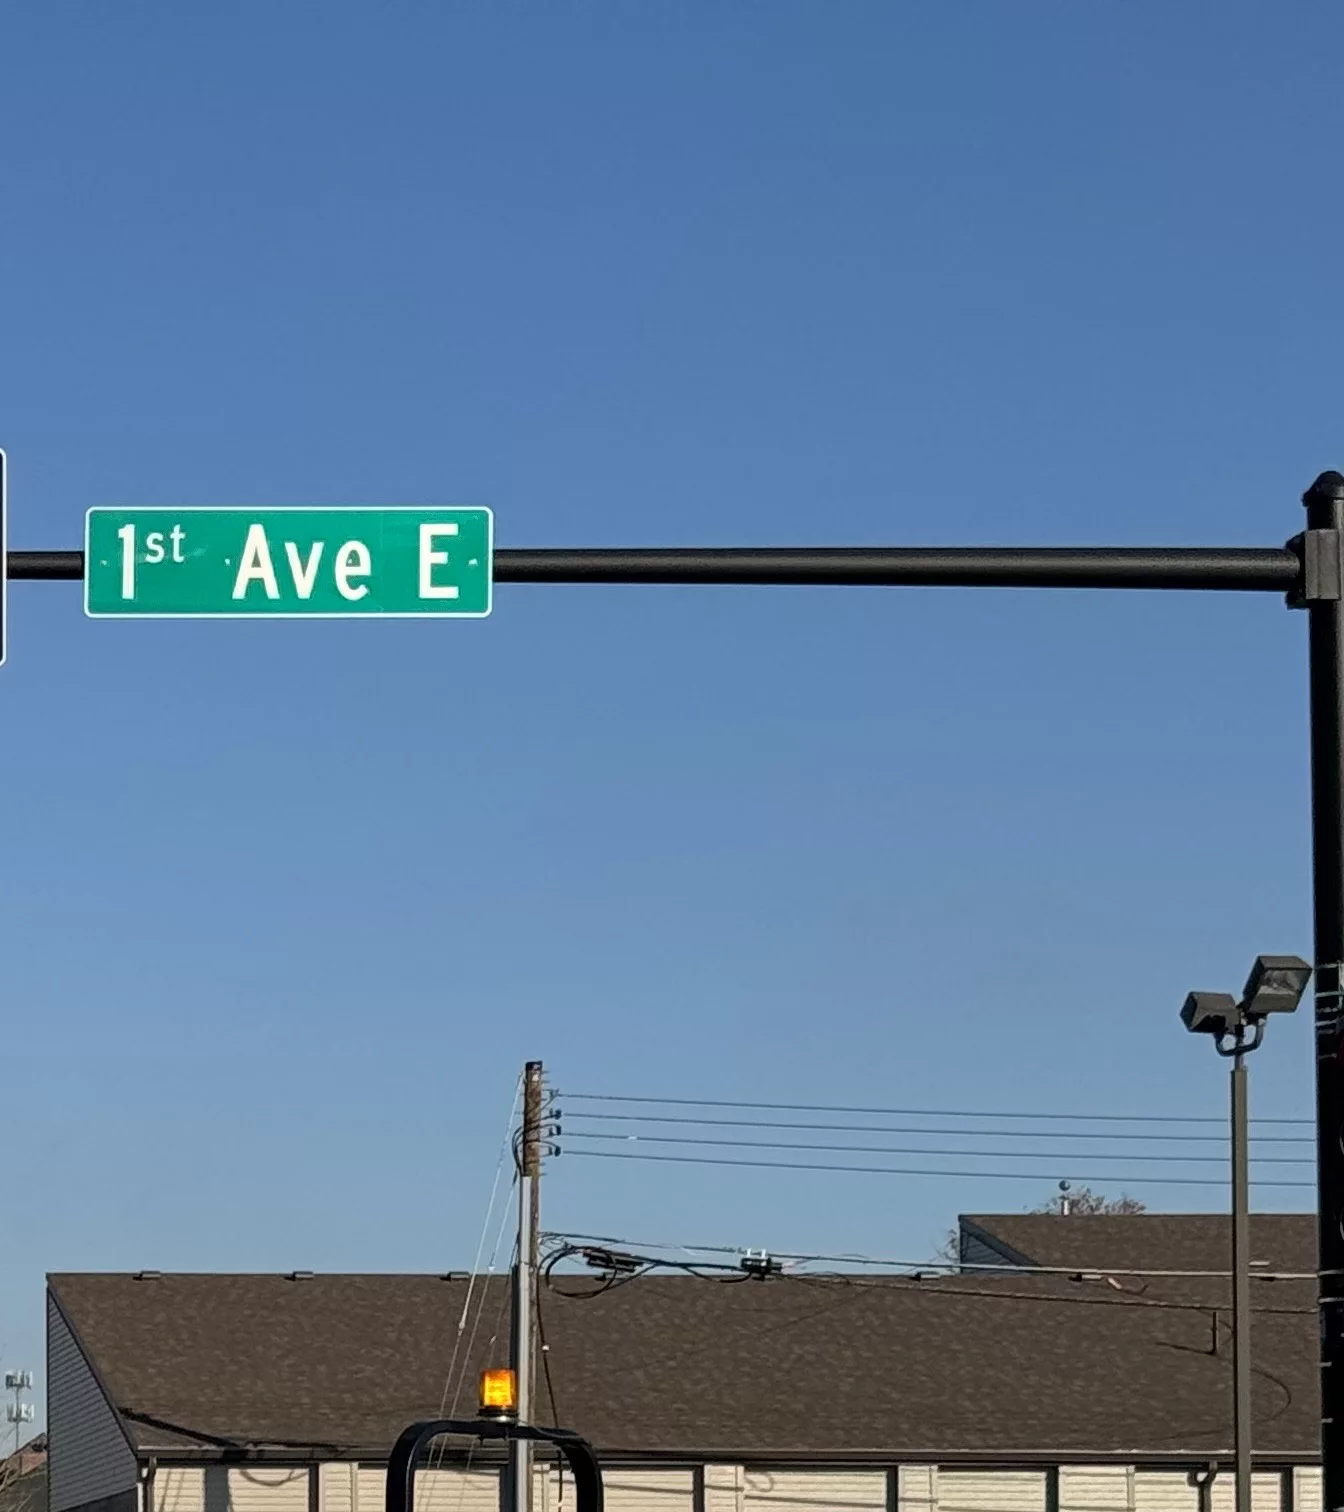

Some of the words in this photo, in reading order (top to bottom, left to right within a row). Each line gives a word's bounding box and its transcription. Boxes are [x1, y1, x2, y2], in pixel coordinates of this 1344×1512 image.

[118, 523, 186, 600] 1st
[231, 523, 372, 601] Ave
[419, 523, 459, 599] E
